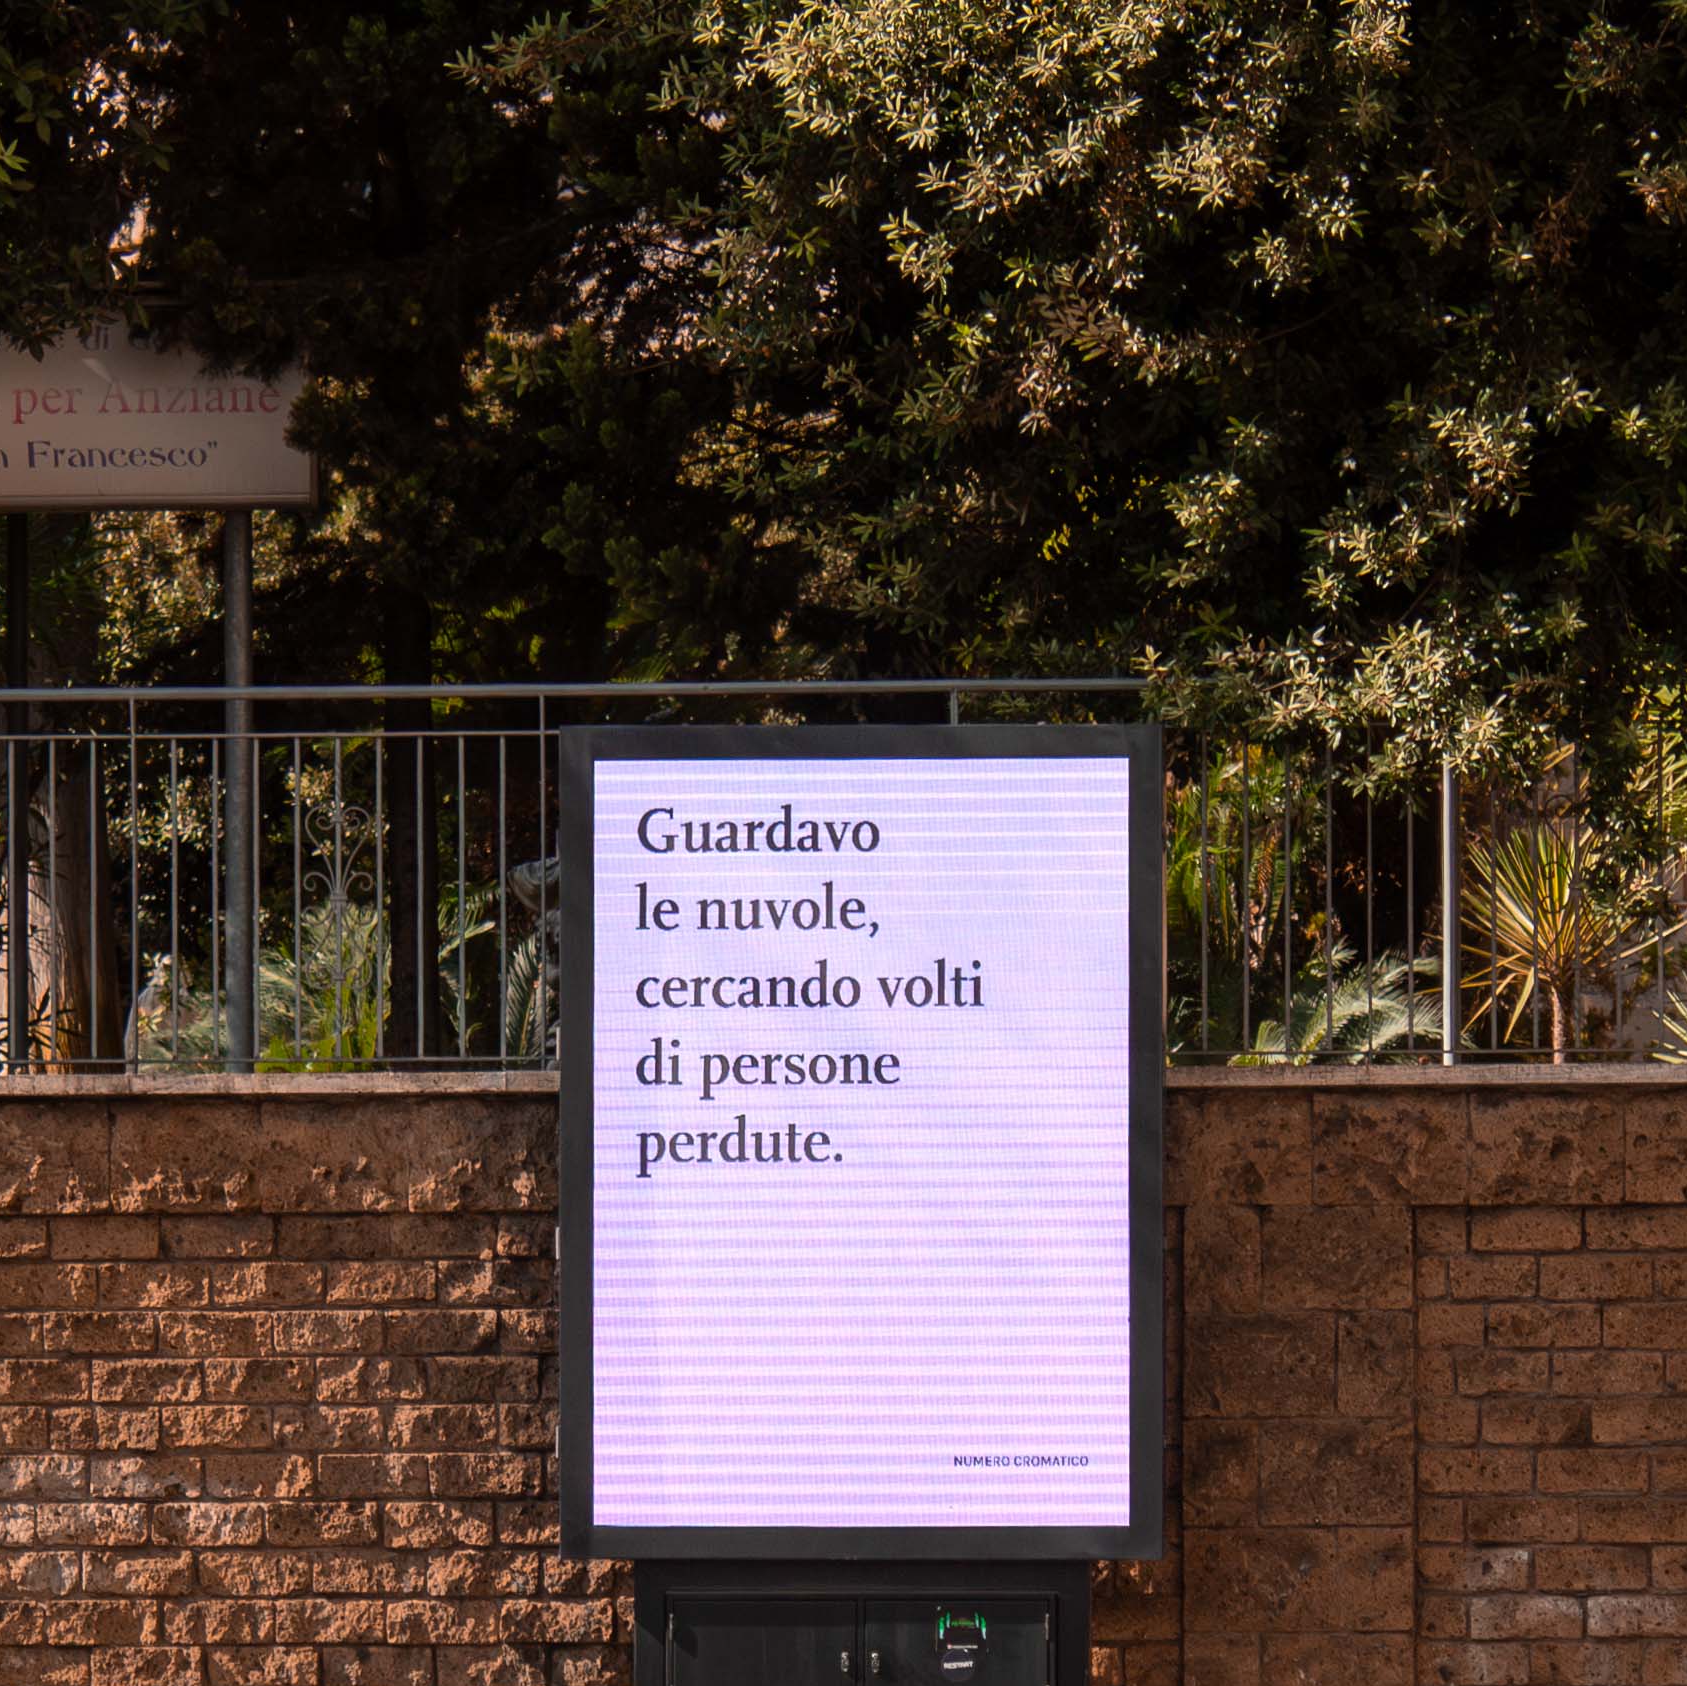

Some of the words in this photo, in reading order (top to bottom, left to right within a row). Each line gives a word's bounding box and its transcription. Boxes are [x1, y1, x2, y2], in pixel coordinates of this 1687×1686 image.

[12, 384, 81, 424] per
[99, 380, 282, 415] Anziane
[637, 803, 880, 854] Guardavo
[634, 881, 680, 931] le
[696, 880, 879, 938] nuvole,
[635, 958, 861, 1009] cercando
[877, 957, 985, 1008] volti
[635, 1036, 683, 1086] di
[699, 1053, 900, 1101] persone
[636, 1114, 843, 1179] perdute.
[953, 1455, 1011, 1467] NUMERO
[1013, 1455, 1089, 1467] CROMATICO
